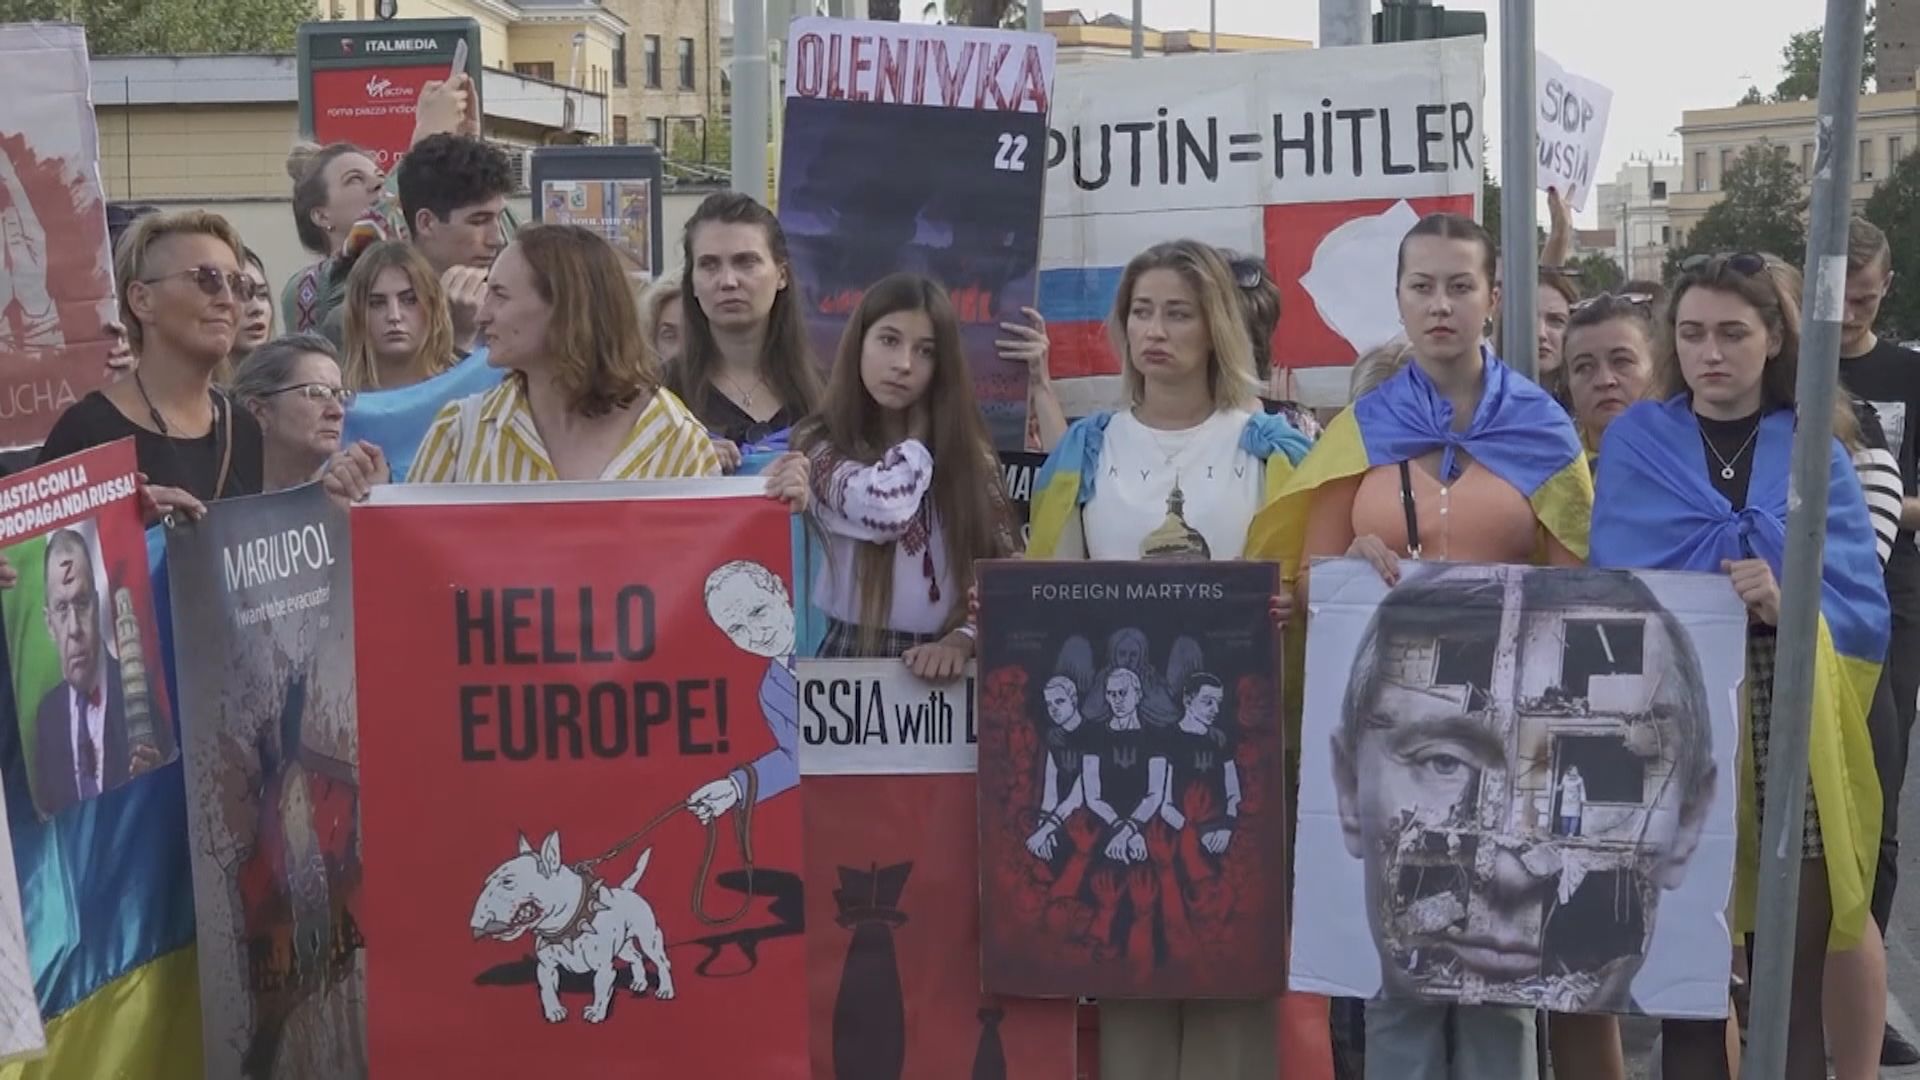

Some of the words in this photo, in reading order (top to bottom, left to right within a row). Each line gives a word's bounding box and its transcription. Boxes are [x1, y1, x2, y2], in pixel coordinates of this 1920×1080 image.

[365, 38, 438, 52] ITALMEDIA
[385, 87, 414, 96] active
[796, 33, 1048, 113] OLENIVKA
[327, 106, 353, 116] roma
[355, 105, 386, 117] piazza
[1541, 78, 1593, 133] STOP
[994, 132, 1028, 172] 22
[37, 468, 70, 497] CON
[70, 464, 88, 488] LA
[0, 487, 92, 540] PROPAGANDA
[90, 472, 136, 507] RUSSA!
[223, 522, 335, 593] MARIUPOL
[1032, 583, 1120, 600] FOREIGN
[1126, 582, 1224, 600] MARTYRS
[240, 605, 267, 626] want
[455, 584, 656, 665] HELLO
[459, 677, 730, 763] EUROPE!
[895, 690, 953, 745] with
